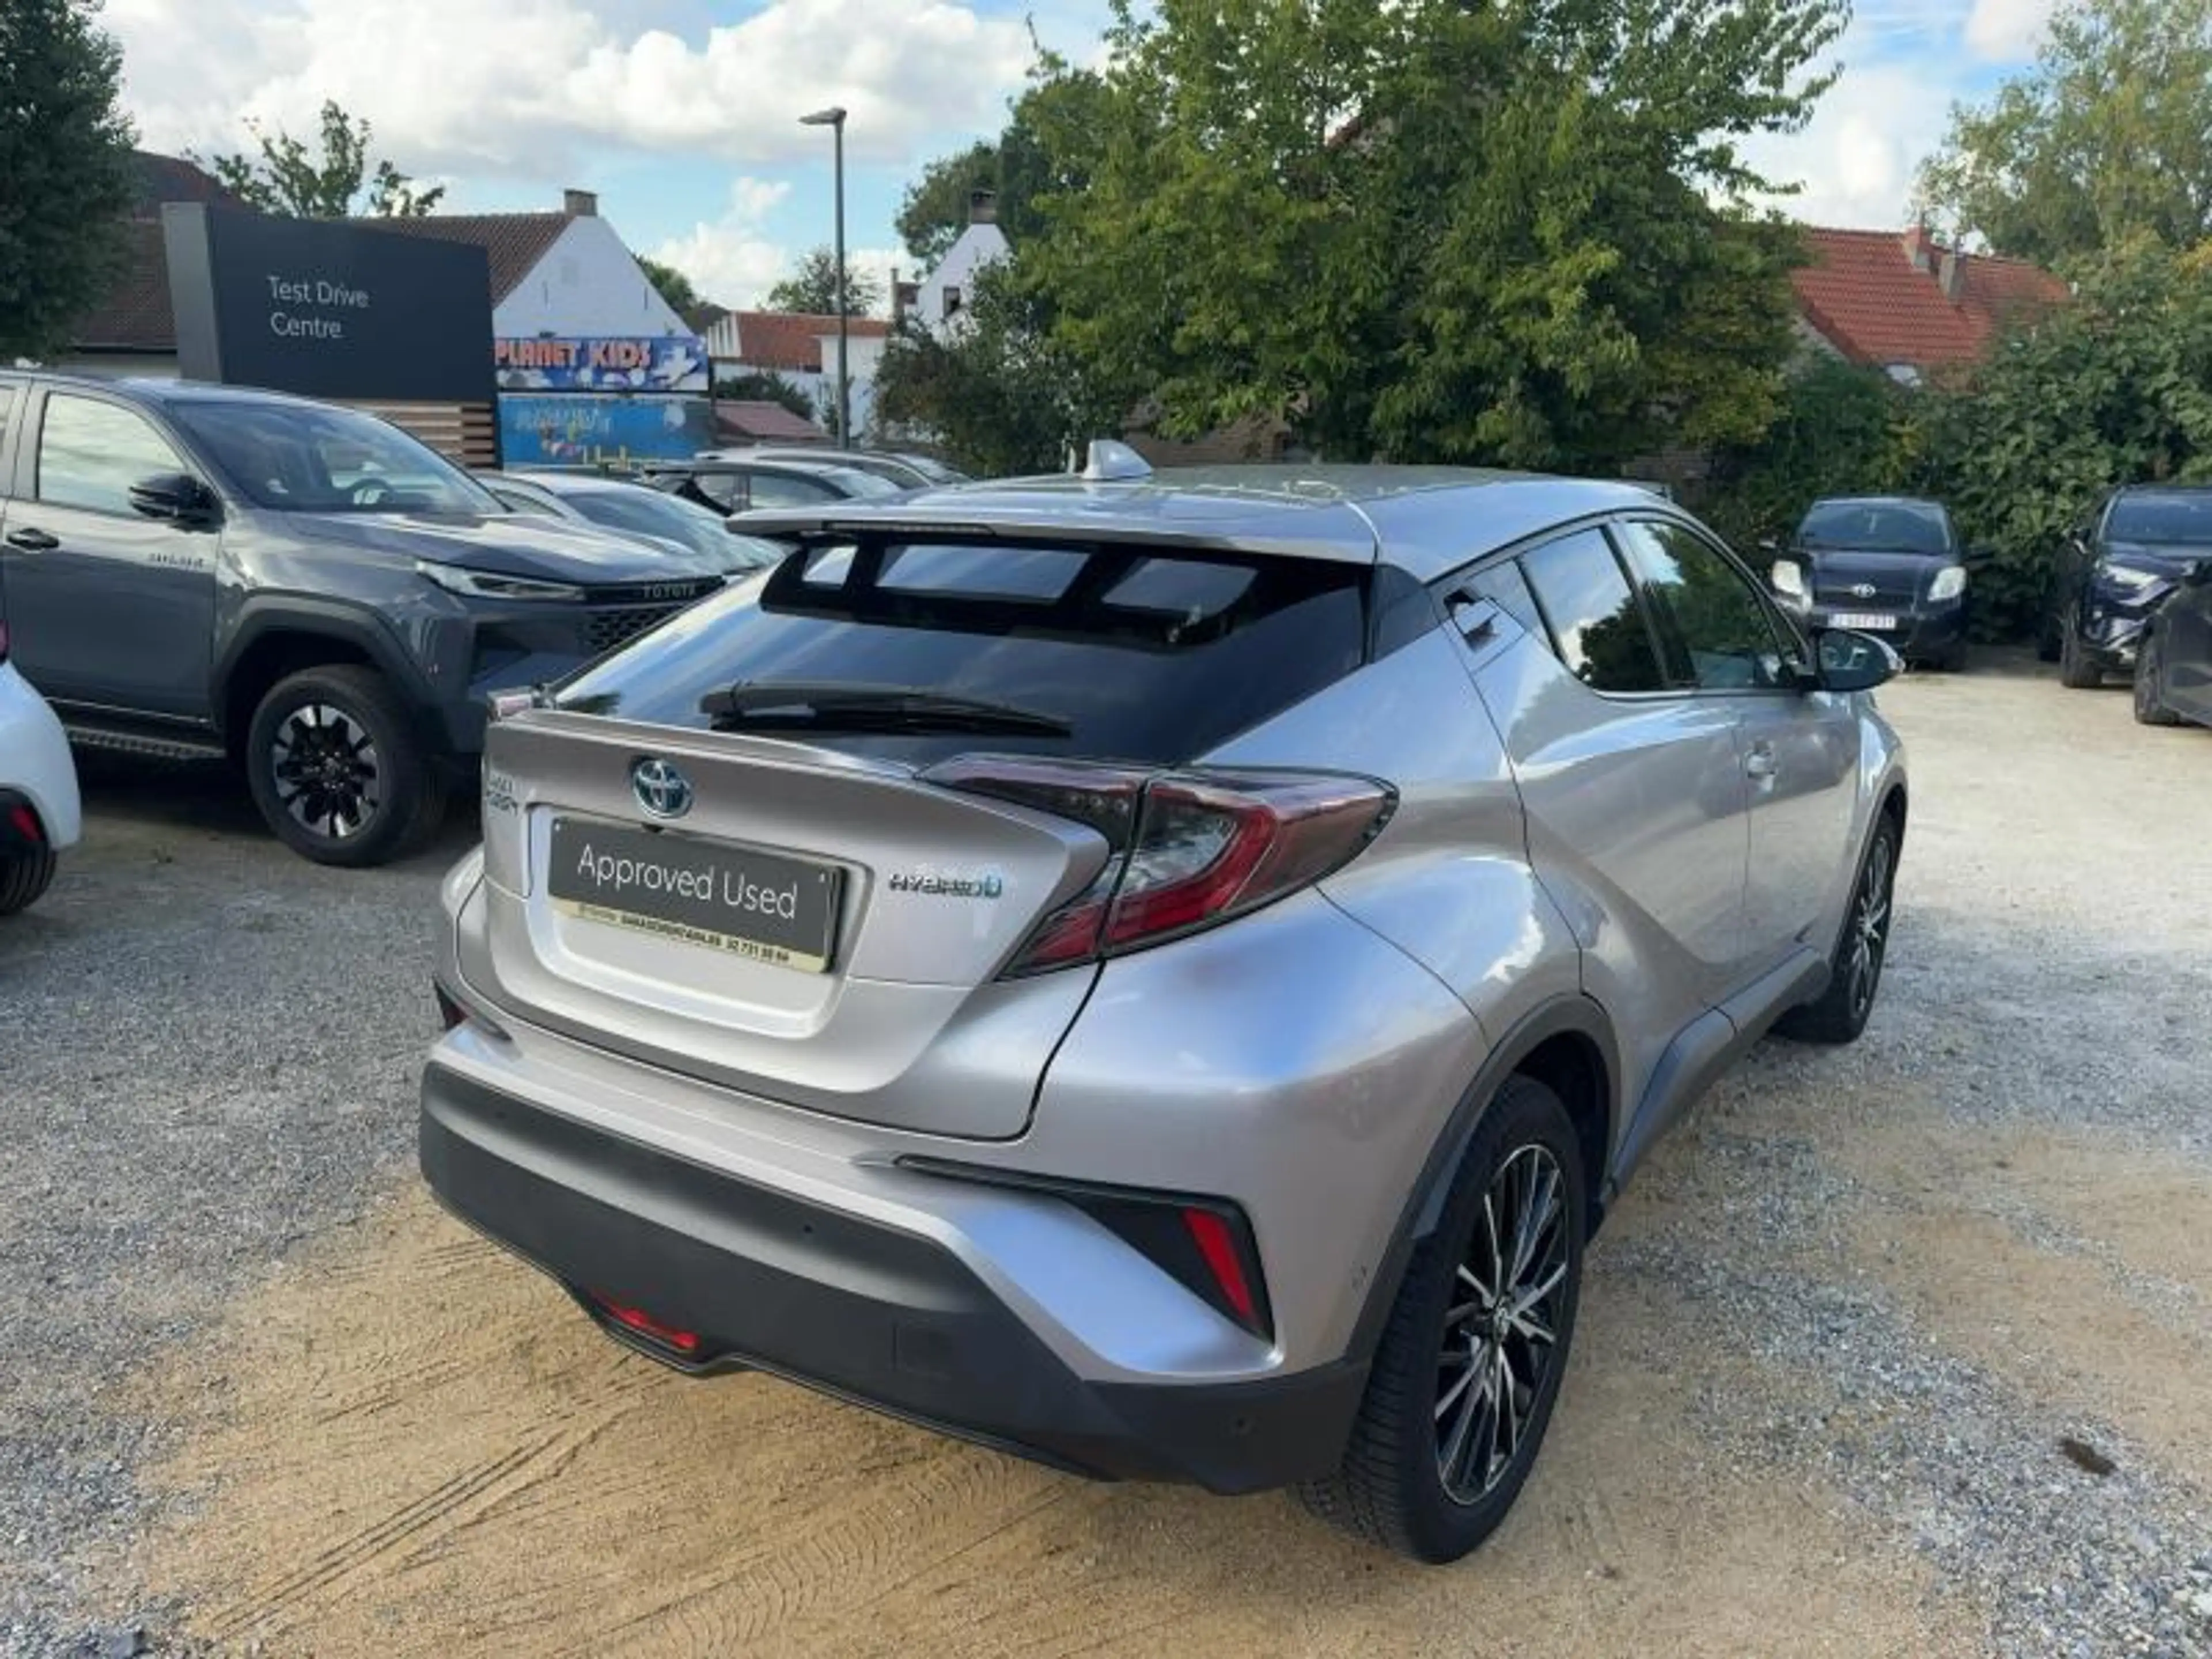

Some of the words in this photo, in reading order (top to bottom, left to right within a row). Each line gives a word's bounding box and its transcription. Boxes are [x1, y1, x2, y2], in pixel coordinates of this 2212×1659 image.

[267, 275, 312, 304] Test
[317, 280, 370, 308] Drive
[271, 312, 346, 339] Centre
[495, 339, 578, 368] PLANET
[588, 339, 652, 369] KIDS
[641, 583, 696, 599] TOYOTA
[578, 843, 715, 902] Approved
[724, 870, 798, 919] Used
